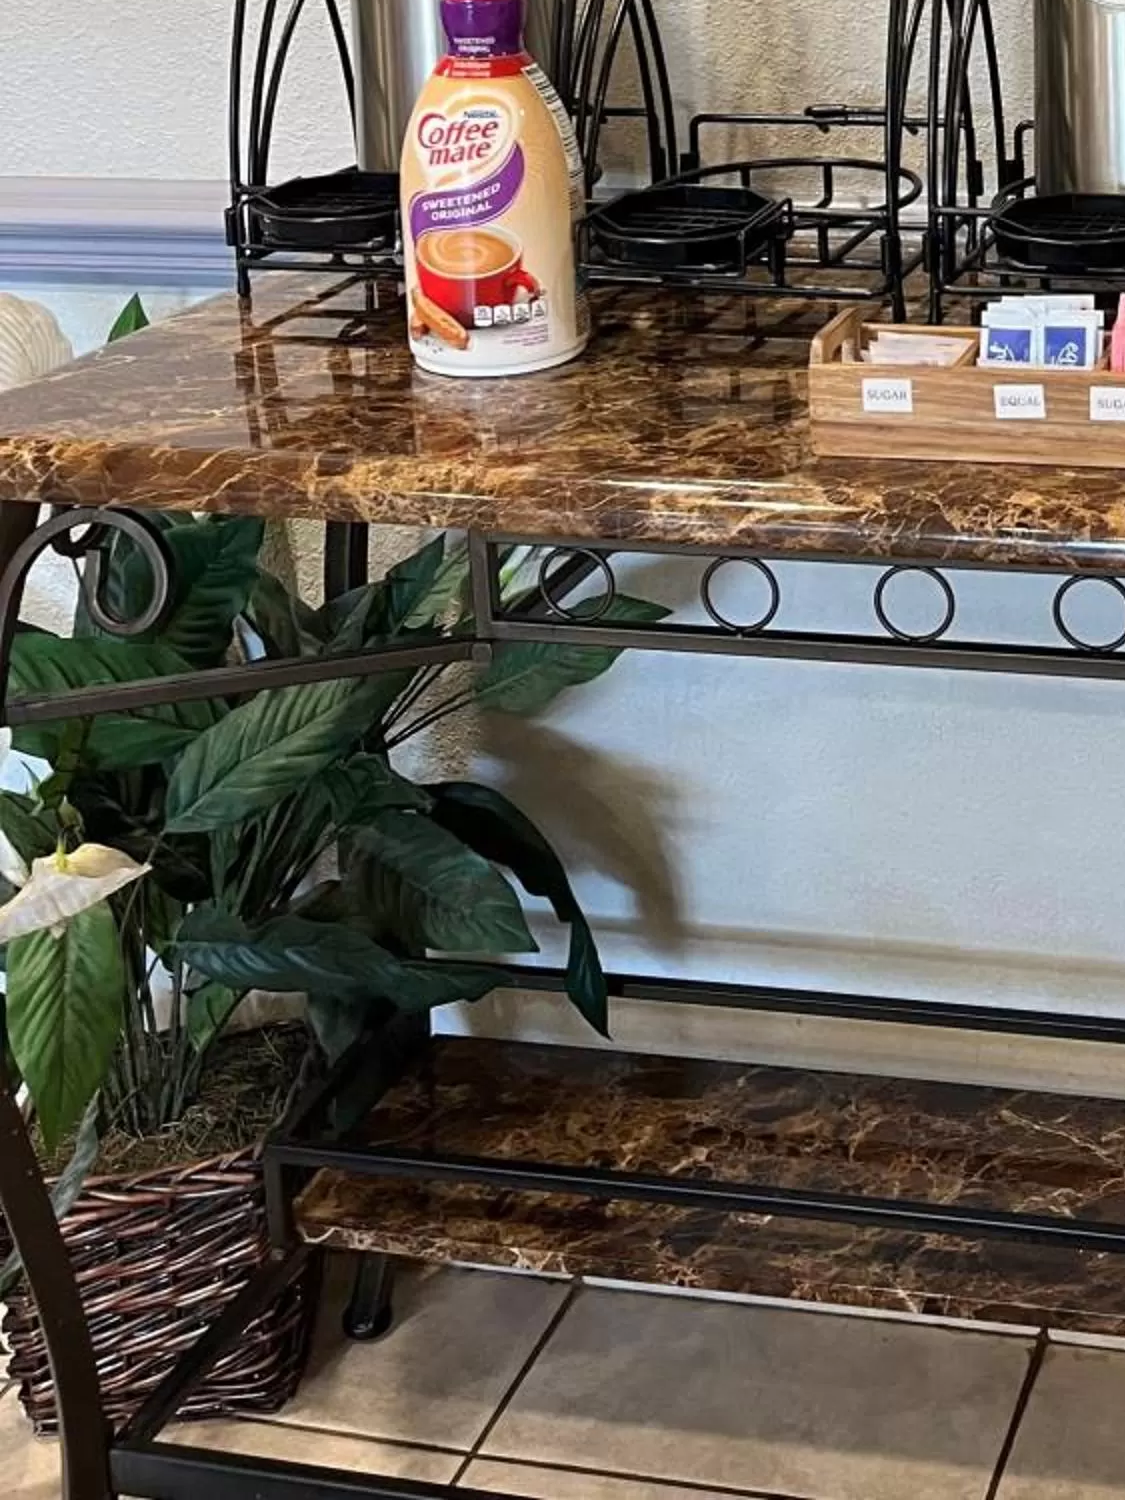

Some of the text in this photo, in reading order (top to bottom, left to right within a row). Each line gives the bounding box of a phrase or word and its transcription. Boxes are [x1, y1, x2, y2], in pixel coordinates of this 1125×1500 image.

[418, 113, 499, 148] Coffee
[429, 141, 491, 165] mate
[422, 182, 501, 211] SWEETENED
[431, 200, 492, 221] ORIGINAL
[867, 389, 908, 402] SUGAR
[1001, 396, 1041, 407] EQUAL
